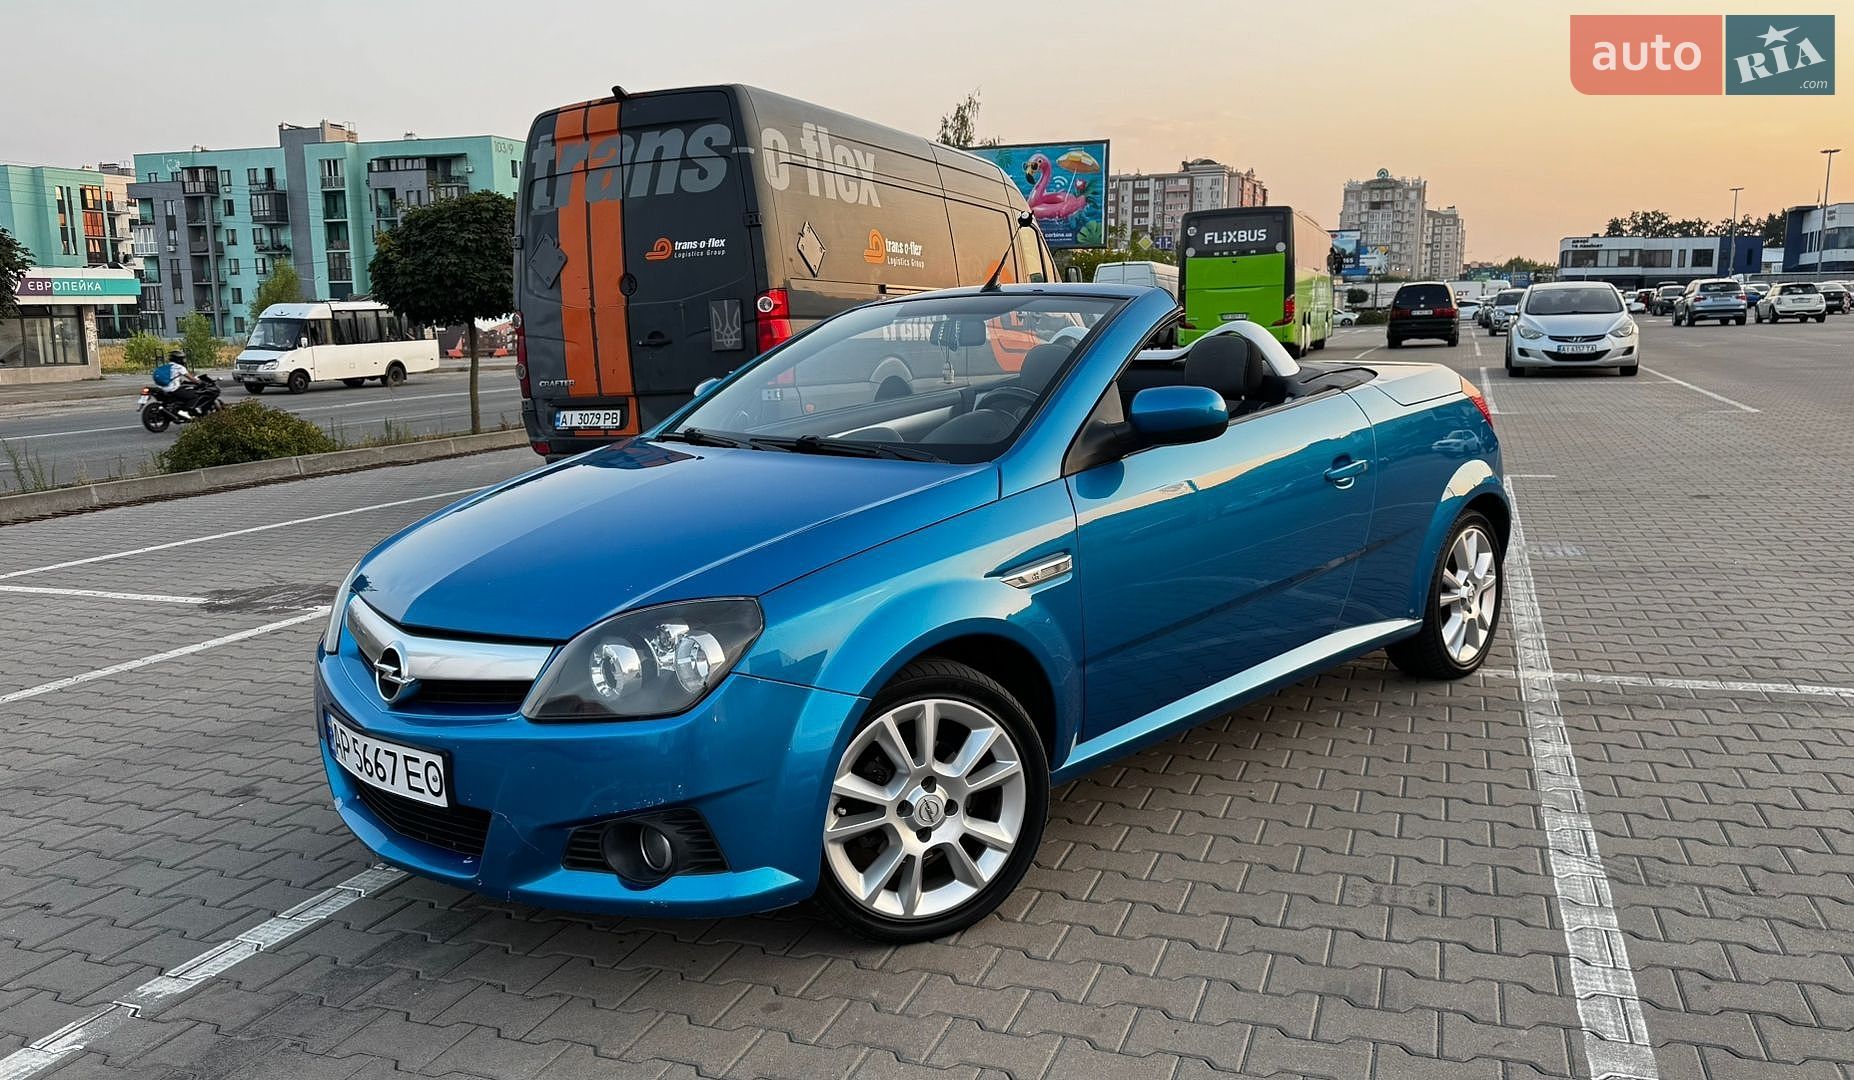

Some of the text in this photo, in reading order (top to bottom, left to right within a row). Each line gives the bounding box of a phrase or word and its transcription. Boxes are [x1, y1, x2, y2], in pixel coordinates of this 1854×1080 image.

[27, 280, 102, 291] ЄВРОПЕЙКА
[539, 379, 575, 387] CRAFTER
[561, 412, 619, 426] AI 3079 PB
[333, 723, 443, 797] AP 5667 EO
